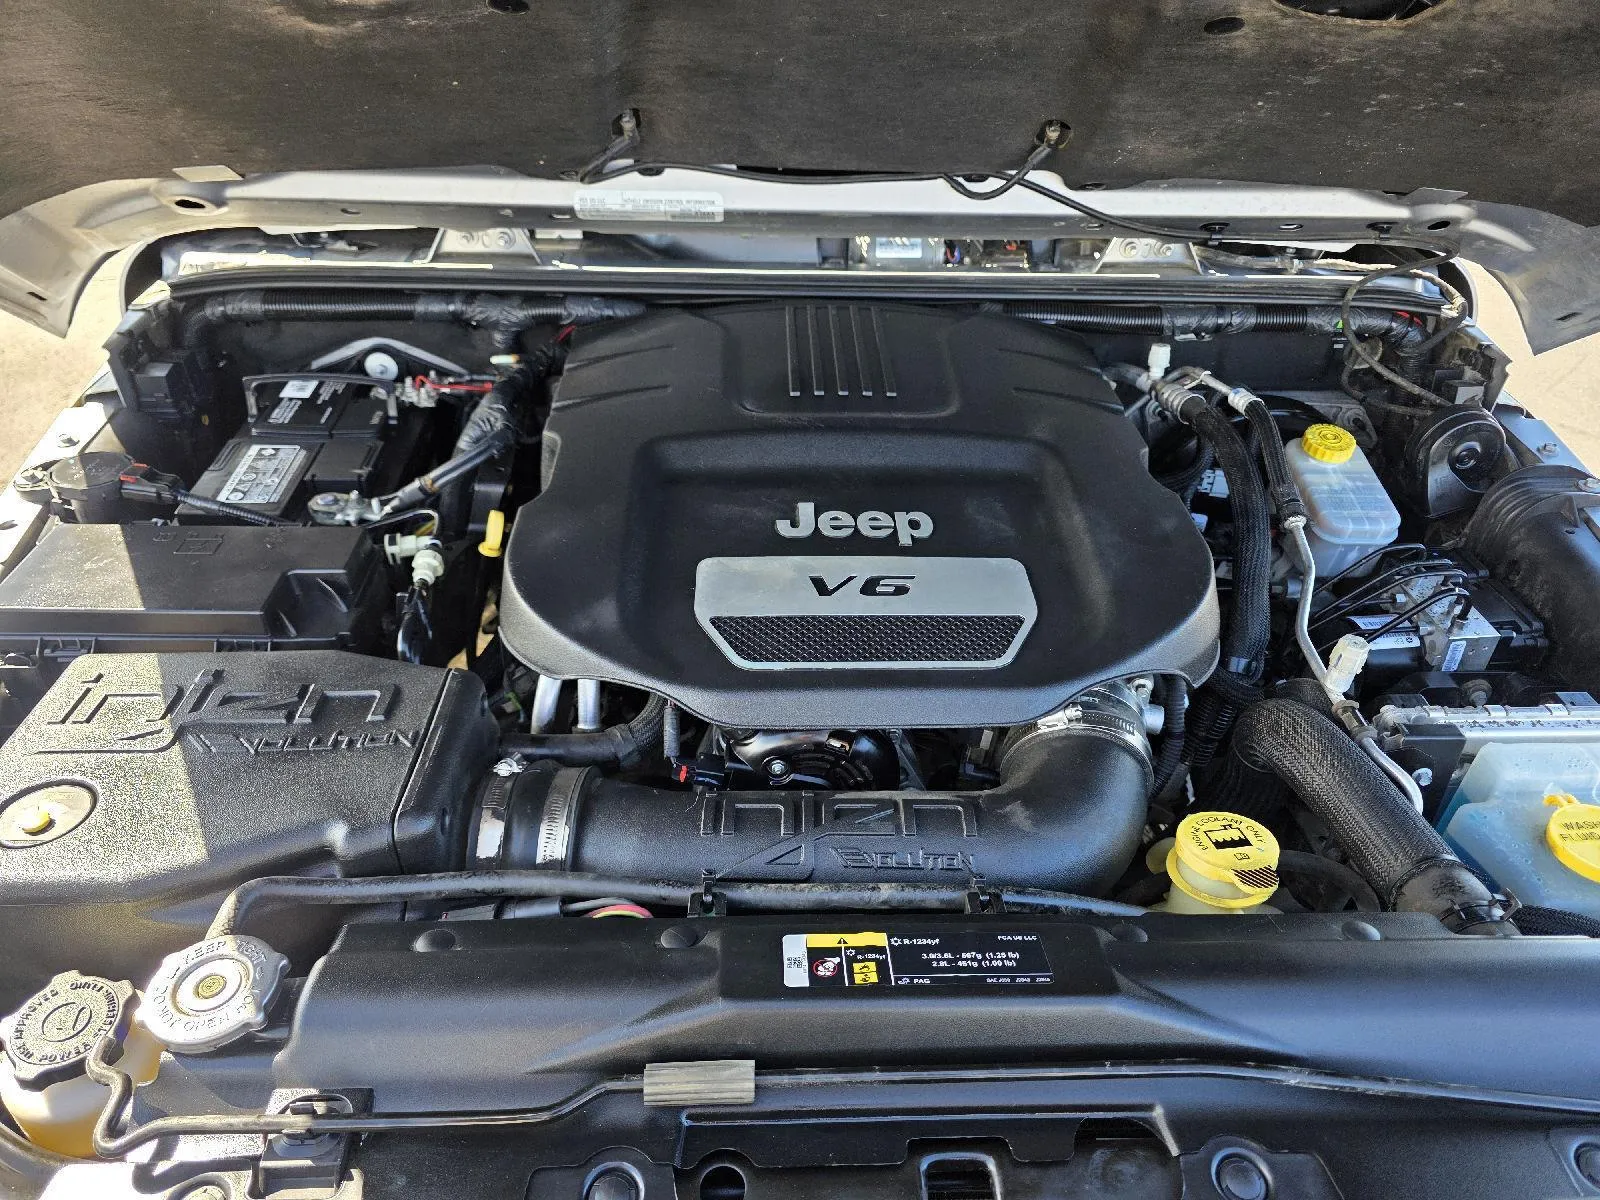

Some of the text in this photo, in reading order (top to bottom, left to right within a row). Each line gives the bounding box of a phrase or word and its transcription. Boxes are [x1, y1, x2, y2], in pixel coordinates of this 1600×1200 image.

[775, 502, 934, 546] Jeep
[808, 575, 917, 597] V6
[1190, 816, 1267, 851] ENGINE COOLANT ONLY
[182, 939, 268, 965] KEEP TIGHT
[902, 938, 940, 946] R-1234yf
[961, 951, 982, 961] 567g
[985, 951, 1007, 961] (1.25
[1008, 950, 1020, 960] lb)
[981, 959, 1002, 968] (1.00
[1003, 959, 1017, 968] lb)
[13, 988, 59, 1041] APPROVED
[183, 1011, 231, 1032] OPEN
[38, 1041, 93, 1062] POWER
